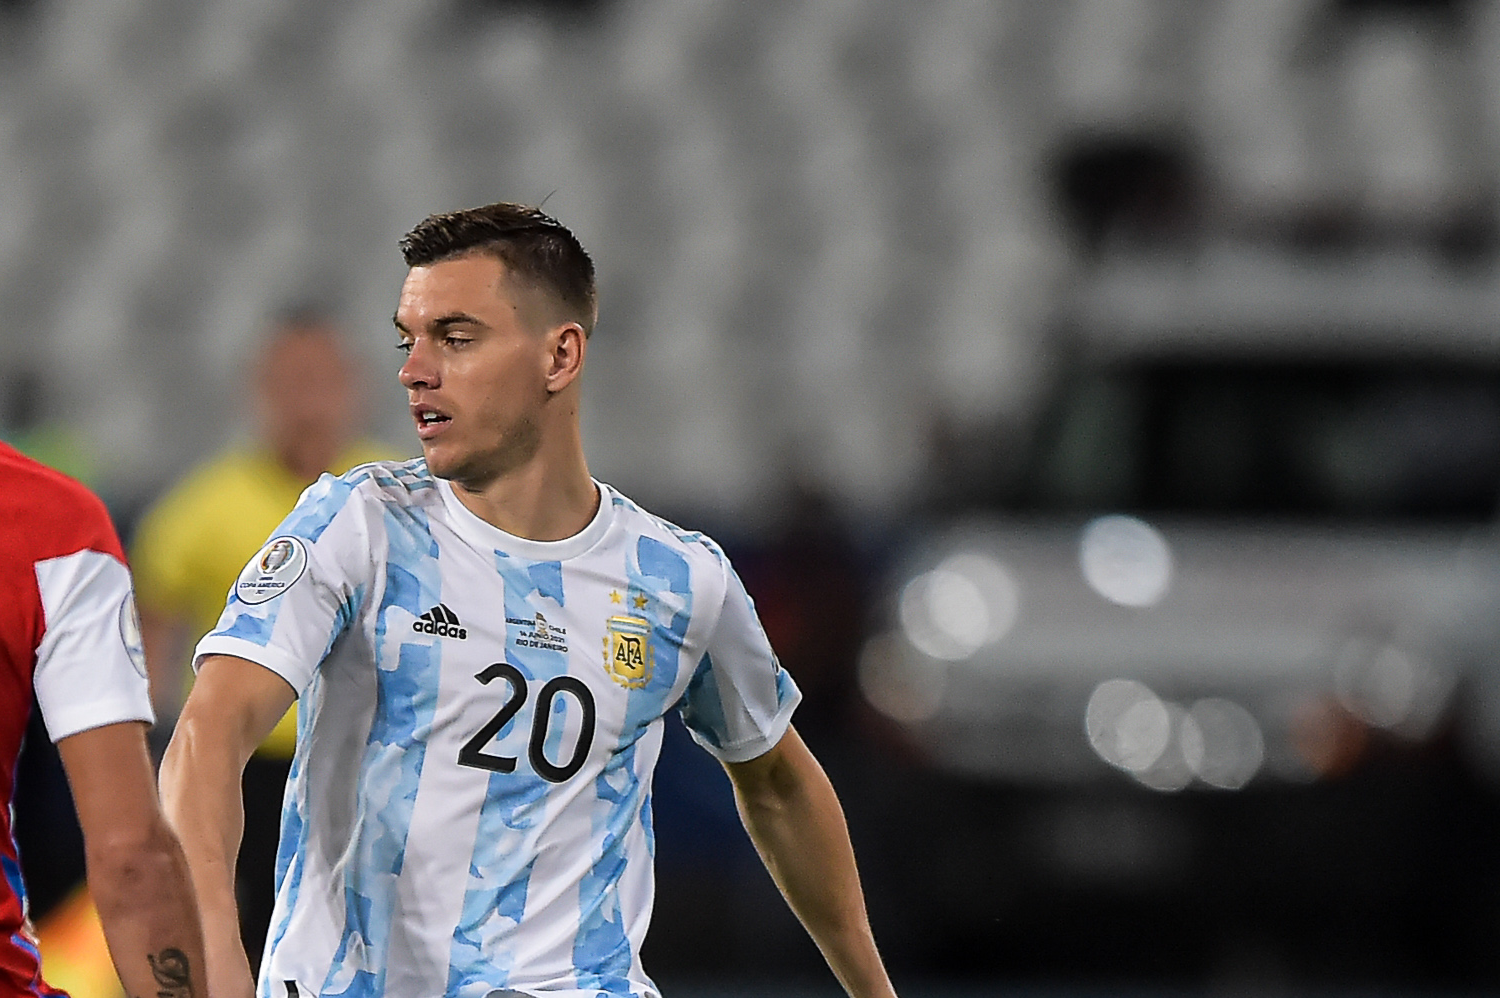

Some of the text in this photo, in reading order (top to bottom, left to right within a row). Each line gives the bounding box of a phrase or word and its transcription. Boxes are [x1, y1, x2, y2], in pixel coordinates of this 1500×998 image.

[412, 621, 468, 641] adidas
[505, 616, 567, 636] ARGENTINA CHILE
[528, 631, 549, 640] JUNIO
[515, 638, 569, 653] RIO DE JANEIRO
[615, 633, 644, 670] AFA
[456, 662, 597, 784] 20
